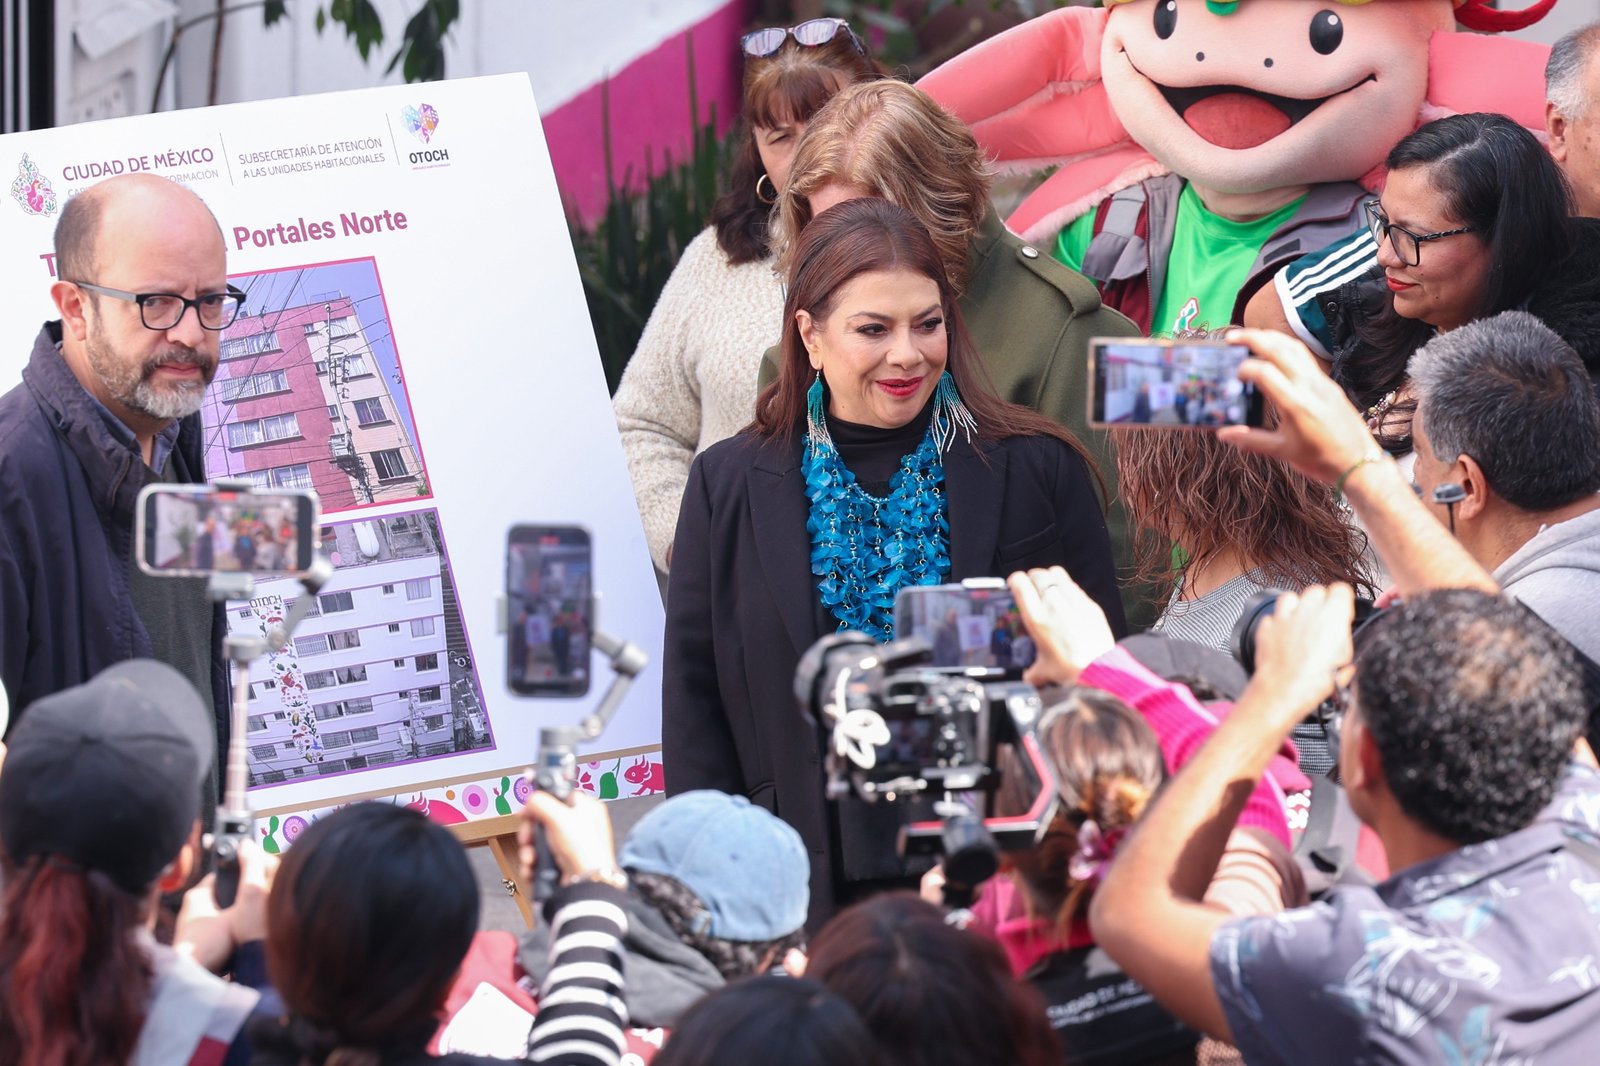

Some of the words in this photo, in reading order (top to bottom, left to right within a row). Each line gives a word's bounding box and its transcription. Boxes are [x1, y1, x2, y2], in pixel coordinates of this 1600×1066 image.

[62, 160, 125, 181] CIUDAD
[128, 156, 151, 173] DE
[154, 148, 214, 169] MÉXICO
[238, 144, 317, 165] SUBSECRETARÍA
[318, 144, 332, 155] DE
[334, 137, 382, 153] ATENCIÓN
[409, 149, 449, 164] OTOCH
[243, 169, 250, 179] A
[250, 166, 267, 178] LAS
[268, 161, 313, 176] UNIDADES
[314, 153, 386, 170] HABITACIONALES
[232, 217, 336, 250] Portales
[339, 209, 408, 237] Norte
